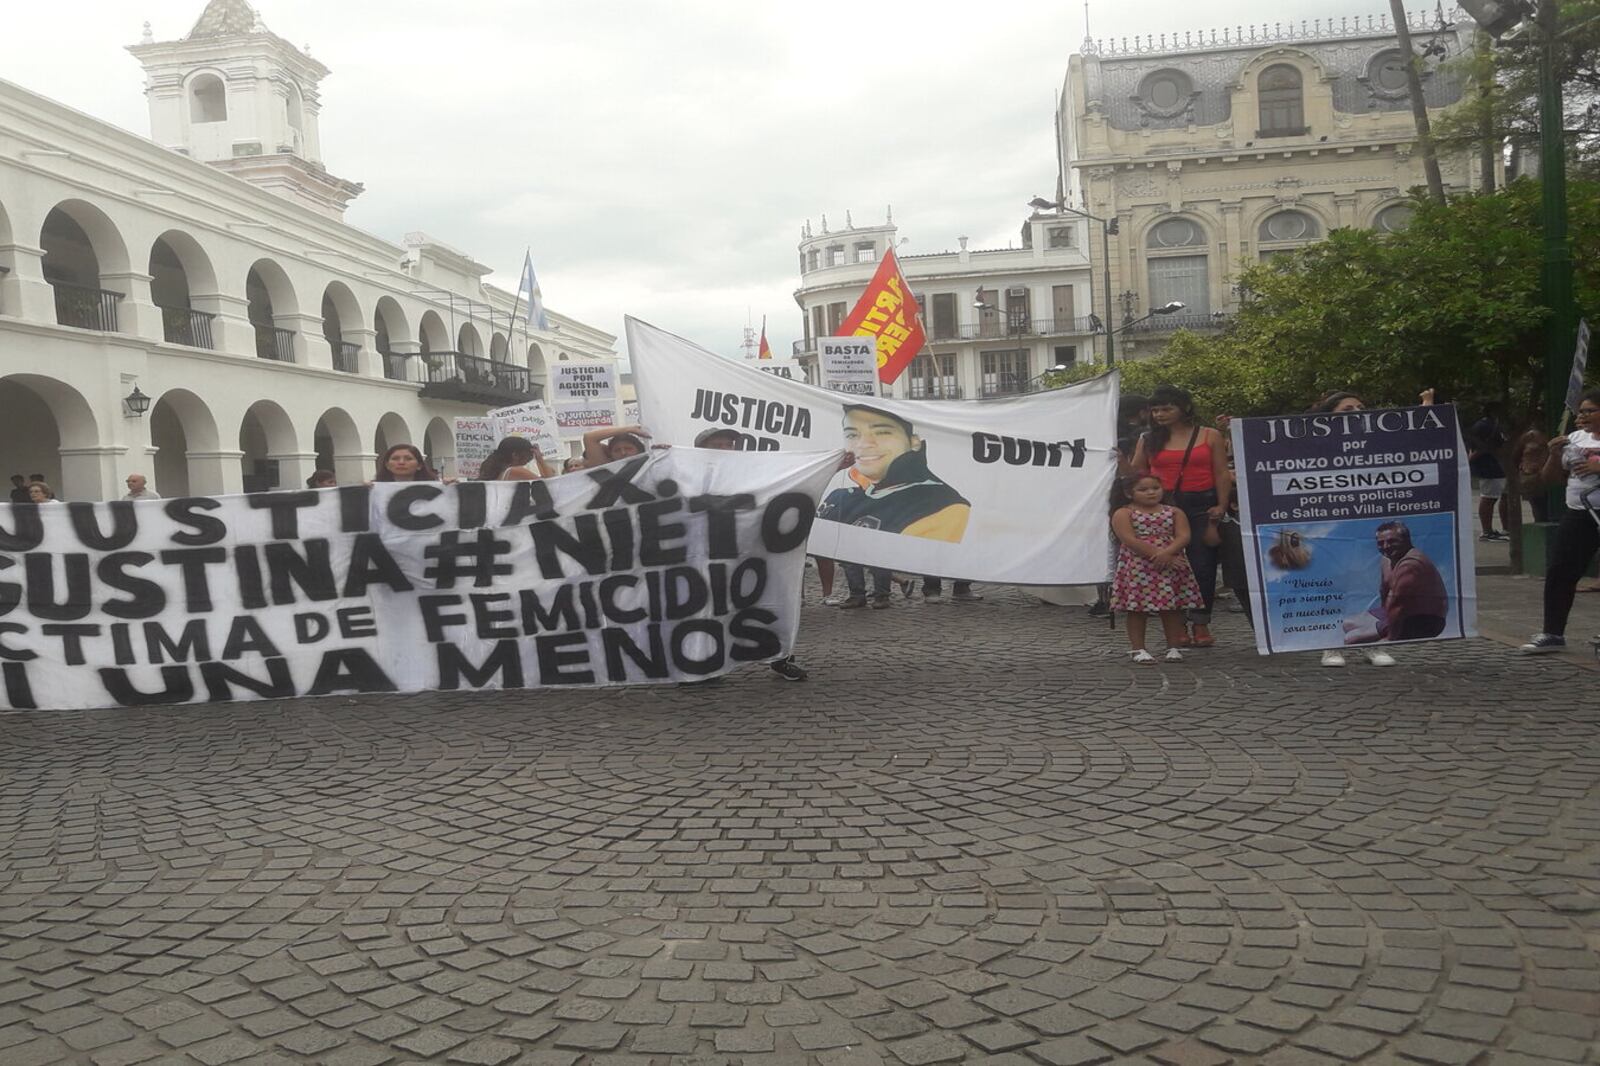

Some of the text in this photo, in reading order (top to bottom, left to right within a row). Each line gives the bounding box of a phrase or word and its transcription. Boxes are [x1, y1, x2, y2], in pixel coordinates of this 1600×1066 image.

[825, 345, 870, 355] BASTA
[561, 366, 606, 375] JUSTICIA
[573, 374, 594, 382] POR
[559, 381, 609, 390] AGUSTINA
[570, 389, 599, 397] NIETO
[691, 388, 812, 438] JUSTICIA
[1262, 409, 1446, 444] JUSTICIA
[1342, 439, 1367, 452] por
[1255, 448, 1454, 472] ALFONZO OVEJERO DAVID
[1286, 469, 1425, 491] ASESINADO
[1300, 495, 1324, 507] por
[1327, 493, 1355, 503] tres
[0, 480, 560, 551] JUSTICIA
[1271, 499, 1441, 520] de Salta en Villa Floresta
[294, 606, 377, 644] DE
[418, 557, 768, 643] FEMICIDIO
[1282, 607, 1342, 619] en nuestros
[98, 647, 399, 706] UNA
[437, 608, 781, 690] MENOS
